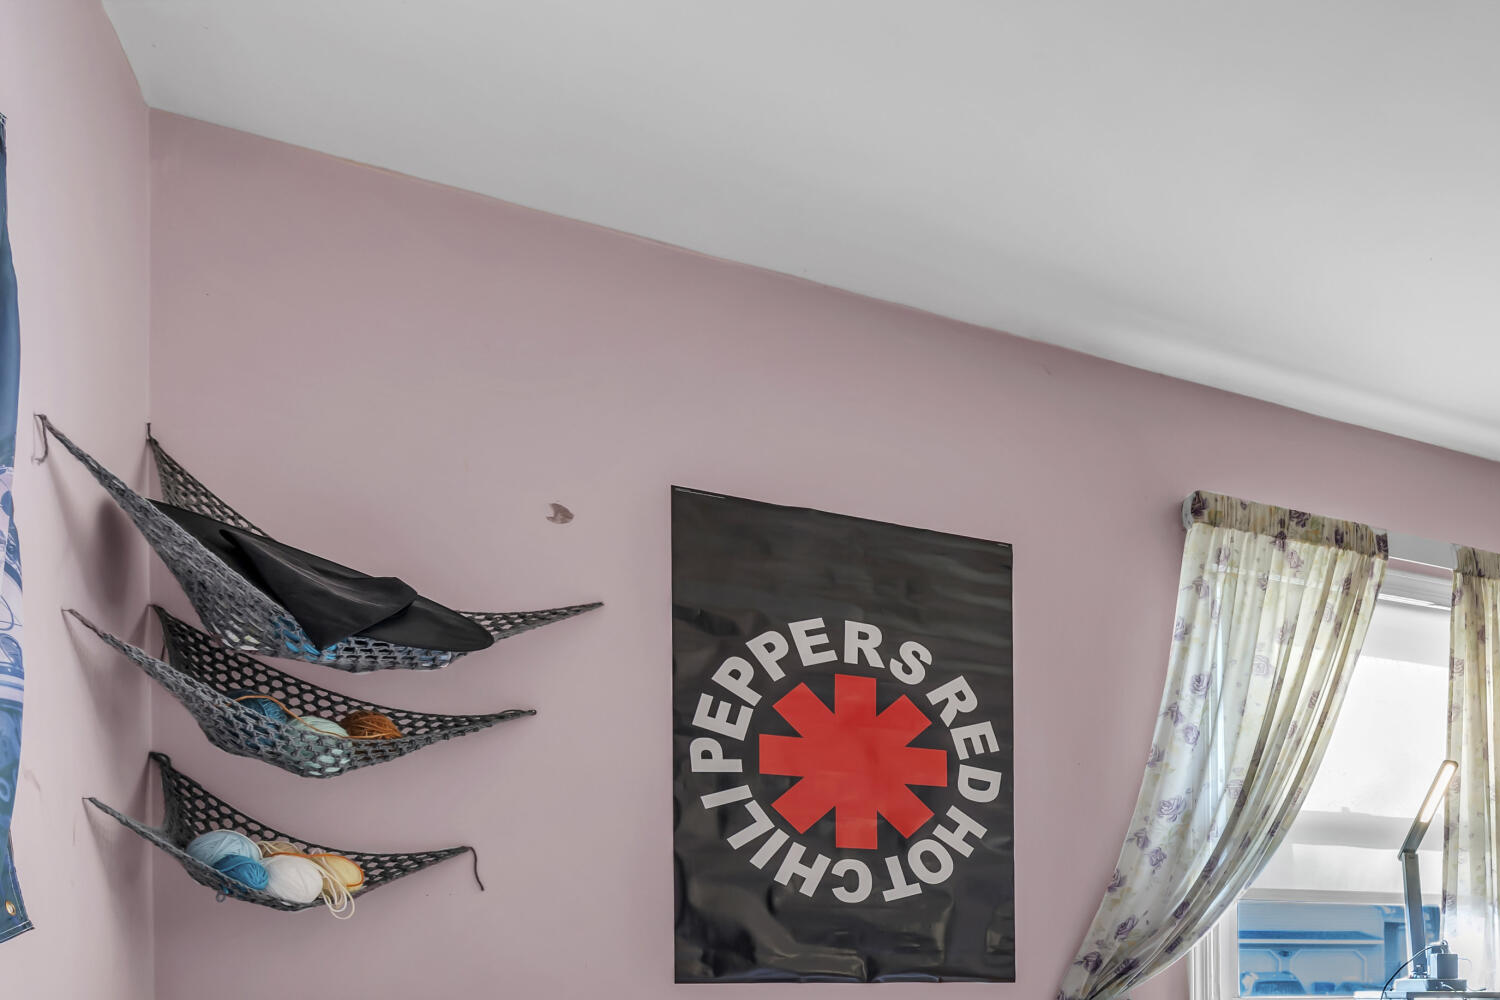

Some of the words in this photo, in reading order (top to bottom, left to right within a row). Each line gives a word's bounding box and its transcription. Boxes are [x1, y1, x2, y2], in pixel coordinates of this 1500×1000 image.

[690, 617, 932, 772] PEPPERS
[926, 675, 1002, 803] RED
[700, 785, 873, 903] CHILI
[882, 805, 988, 902] HOT
